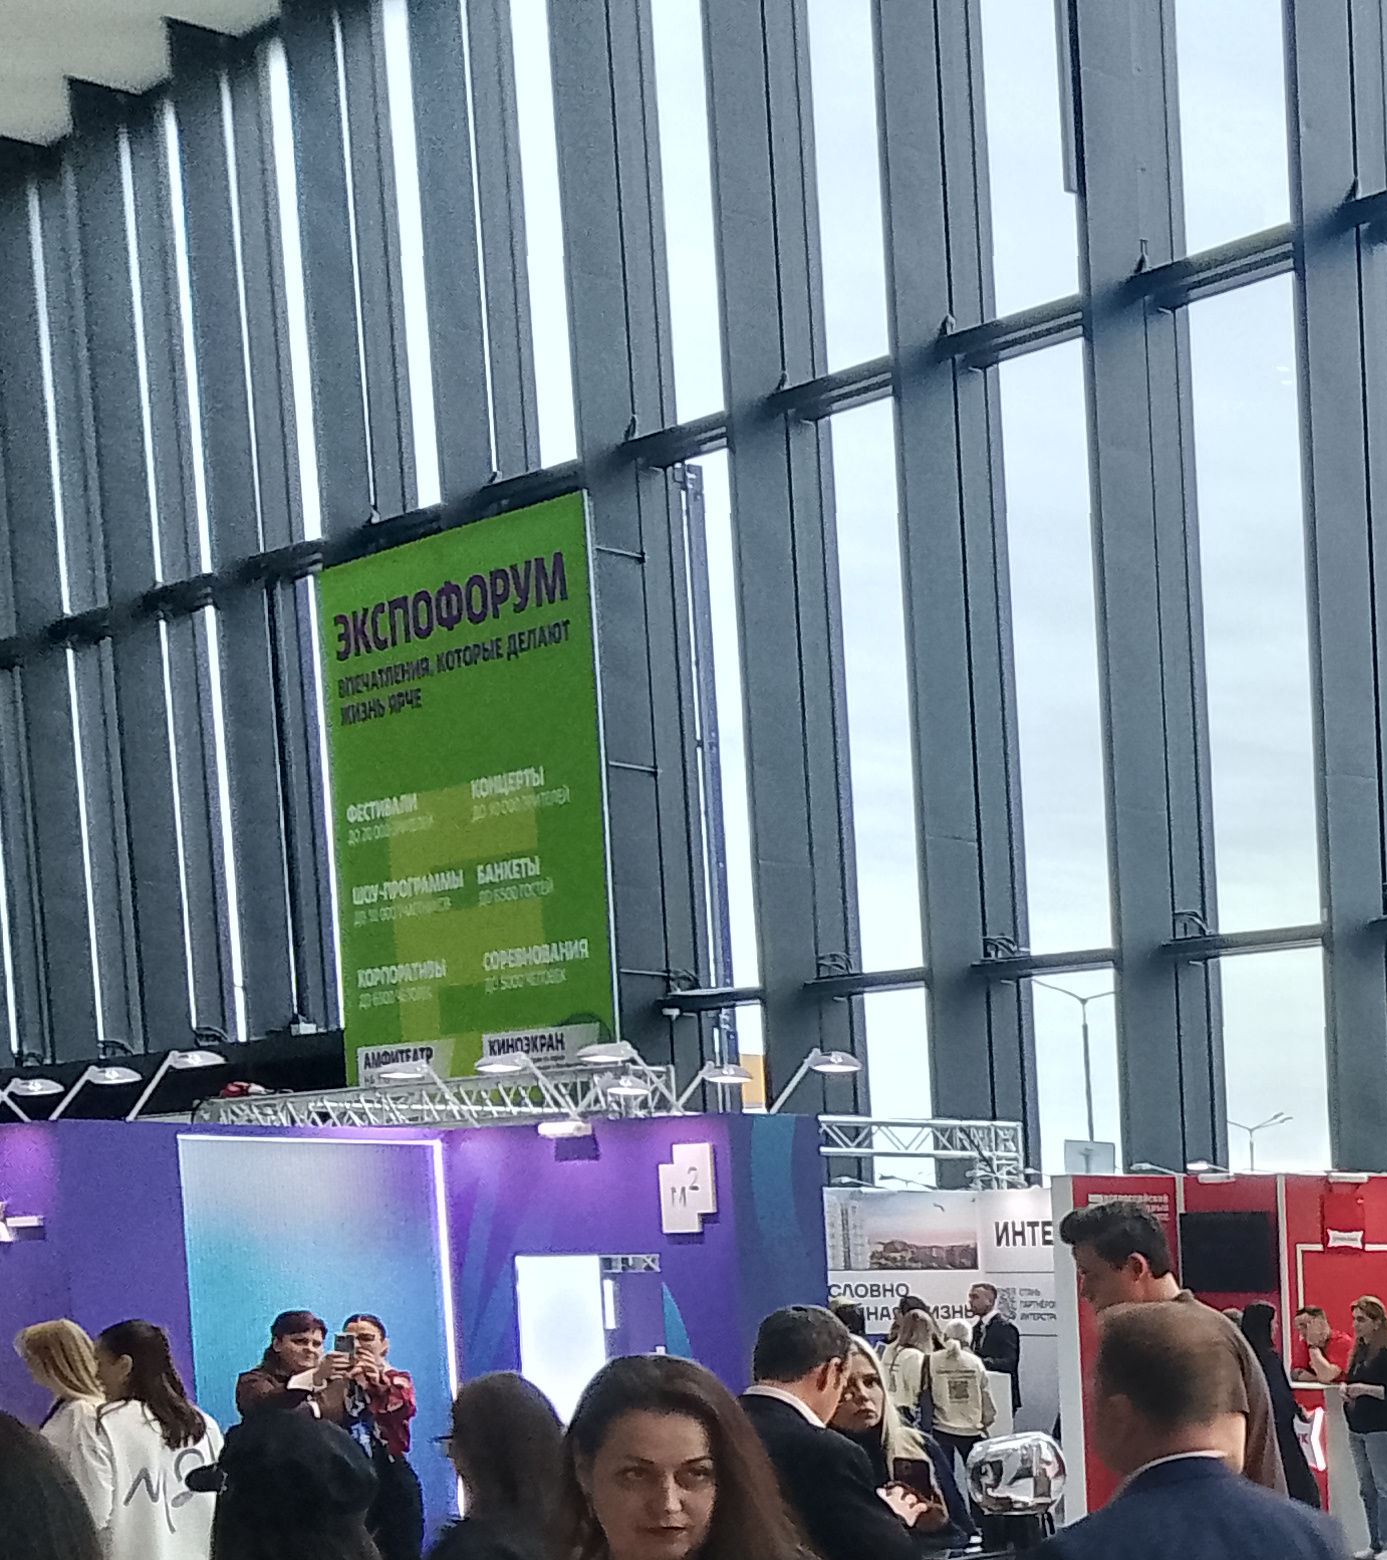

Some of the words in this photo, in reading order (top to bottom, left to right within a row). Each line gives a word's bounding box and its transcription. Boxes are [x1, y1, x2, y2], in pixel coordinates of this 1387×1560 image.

[333, 552, 568, 661] ЭКСПОФОРУМ
[437, 637, 503, 672] КОТОРЫЕ
[506, 620, 570, 661] ДЕЛАЮТ
[341, 697, 386, 726] ЖИЗНЬ
[389, 688, 422, 715] ЯРЧЕ
[470, 766, 544, 799] КОНЦЕРТЫ
[346, 792, 418, 823] ФЕСТИВАЛИ
[477, 855, 541, 885] БАНКЕТЫ
[353, 869, 464, 905] ШОУ-ПРОГРАММЫ
[483, 938, 590, 972] СОРЕВНОВАНИЯ
[357, 959, 447, 989] КОРПОРАТИВЫ
[364, 1047, 434, 1070] АМФИТЕАТР
[488, 1032, 566, 1056] КИНОЭКРАН
[994, 1221, 1055, 1247] ИНТЕ
[928, 1303, 975, 1320] ИЗНЬ
